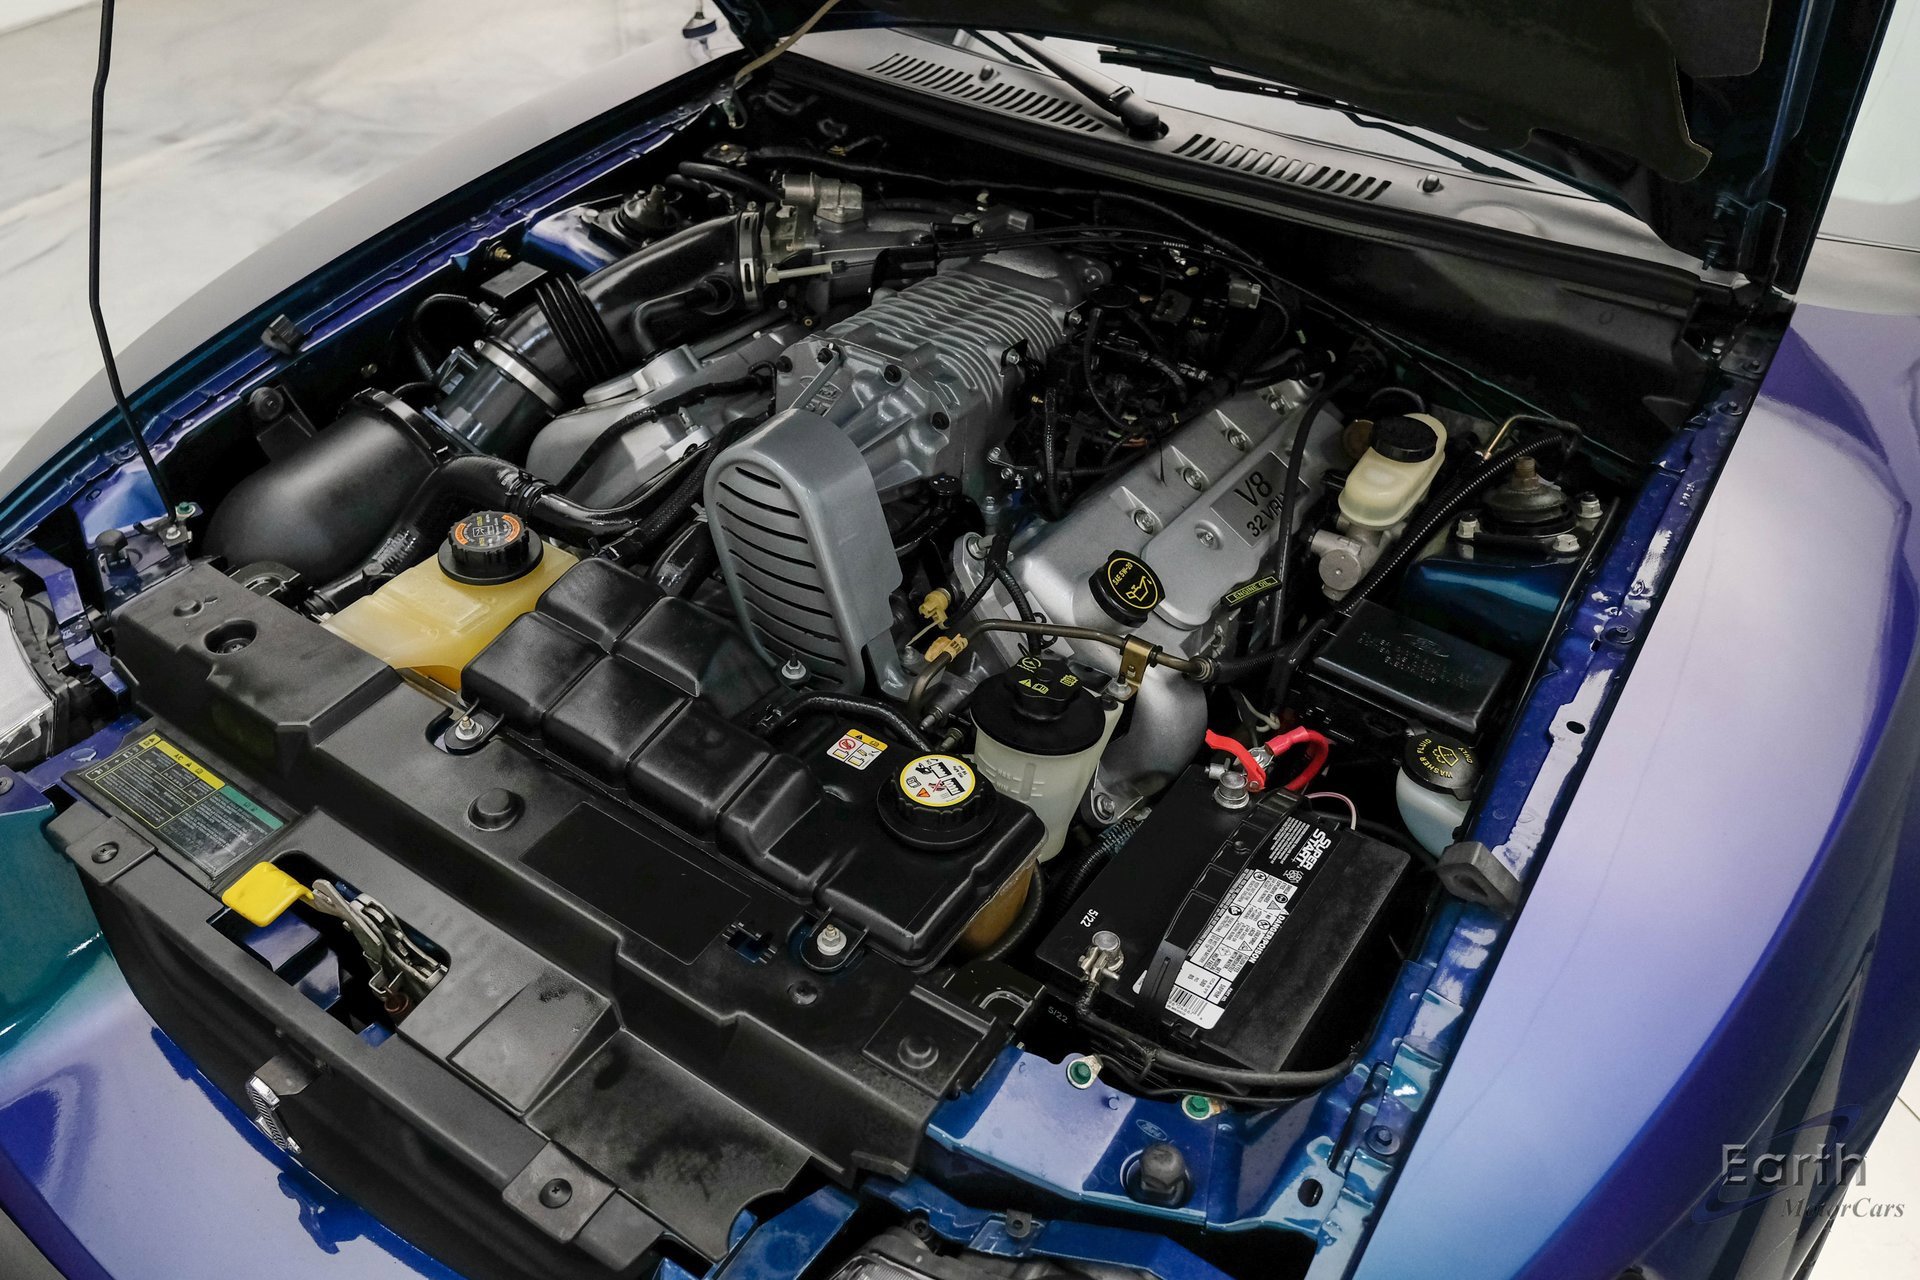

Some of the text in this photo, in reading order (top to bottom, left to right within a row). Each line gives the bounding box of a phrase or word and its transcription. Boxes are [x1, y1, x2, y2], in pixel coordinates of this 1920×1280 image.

[1234, 472, 1272, 506] V8
[1246, 514, 1268, 537] 32
[1233, 580, 1271, 599] ENGINE OIL
[1416, 738, 1473, 778] WASHER FLUID ONLY
[1294, 828, 1327, 867] START
[1302, 836, 1332, 870] SUPER
[1080, 908, 1099, 927] 5/22
[1248, 914, 1285, 963] DANGER/POISON
